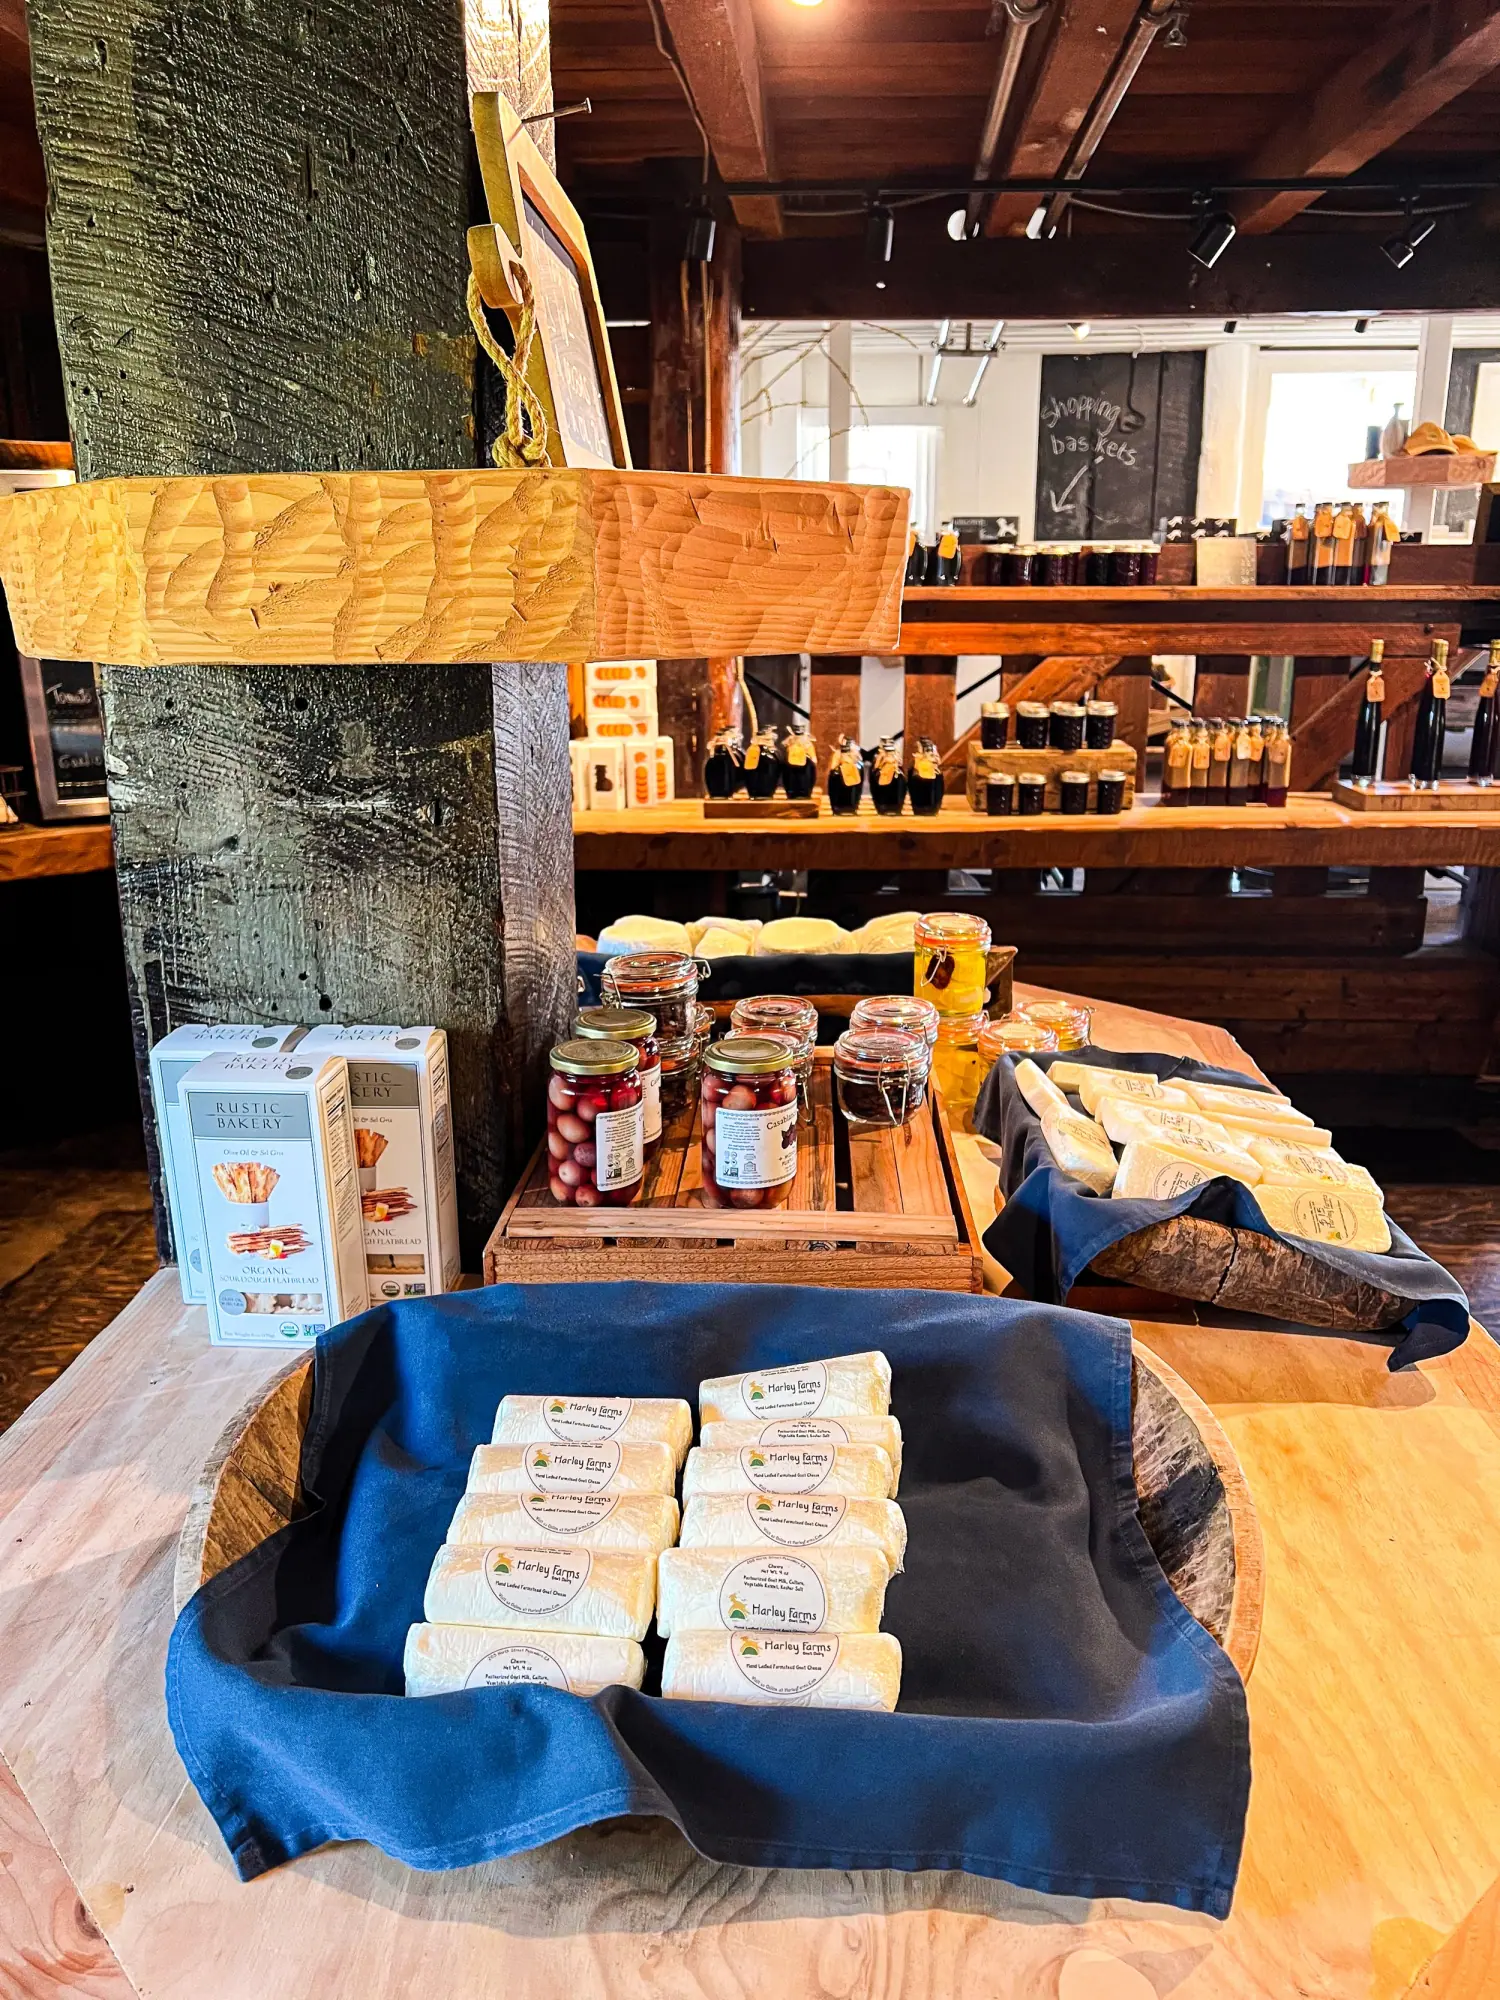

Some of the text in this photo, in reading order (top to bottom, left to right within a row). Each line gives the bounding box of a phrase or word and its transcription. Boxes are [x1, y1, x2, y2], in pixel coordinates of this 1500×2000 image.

[354, 1073, 391, 1083] STIC
[351, 1087, 392, 1097] KERY
[216, 1102, 281, 1114] RUSTIC
[217, 1118, 282, 1129] BAKERY
[242, 1266, 293, 1275] ORGANIC
[221, 1275, 271, 1283] SOURDOUGH
[768, 1381, 821, 1394] Harley Farms
[570, 1403, 622, 1416] Harley Farms
[554, 1456, 612, 1469] Harley Farms
[770, 1453, 828, 1464] Harley Farms
[551, 1494, 583, 1503] Harley
[777, 1500, 838, 1513] Harley Farms
[517, 1560, 580, 1579] Harley Farms
[520, 1584, 541, 1593] Farmstead
[752, 1603, 817, 1621] Harley Farms
[765, 1641, 831, 1654] Harley Farms
[752, 1676, 760, 1685] Visit
